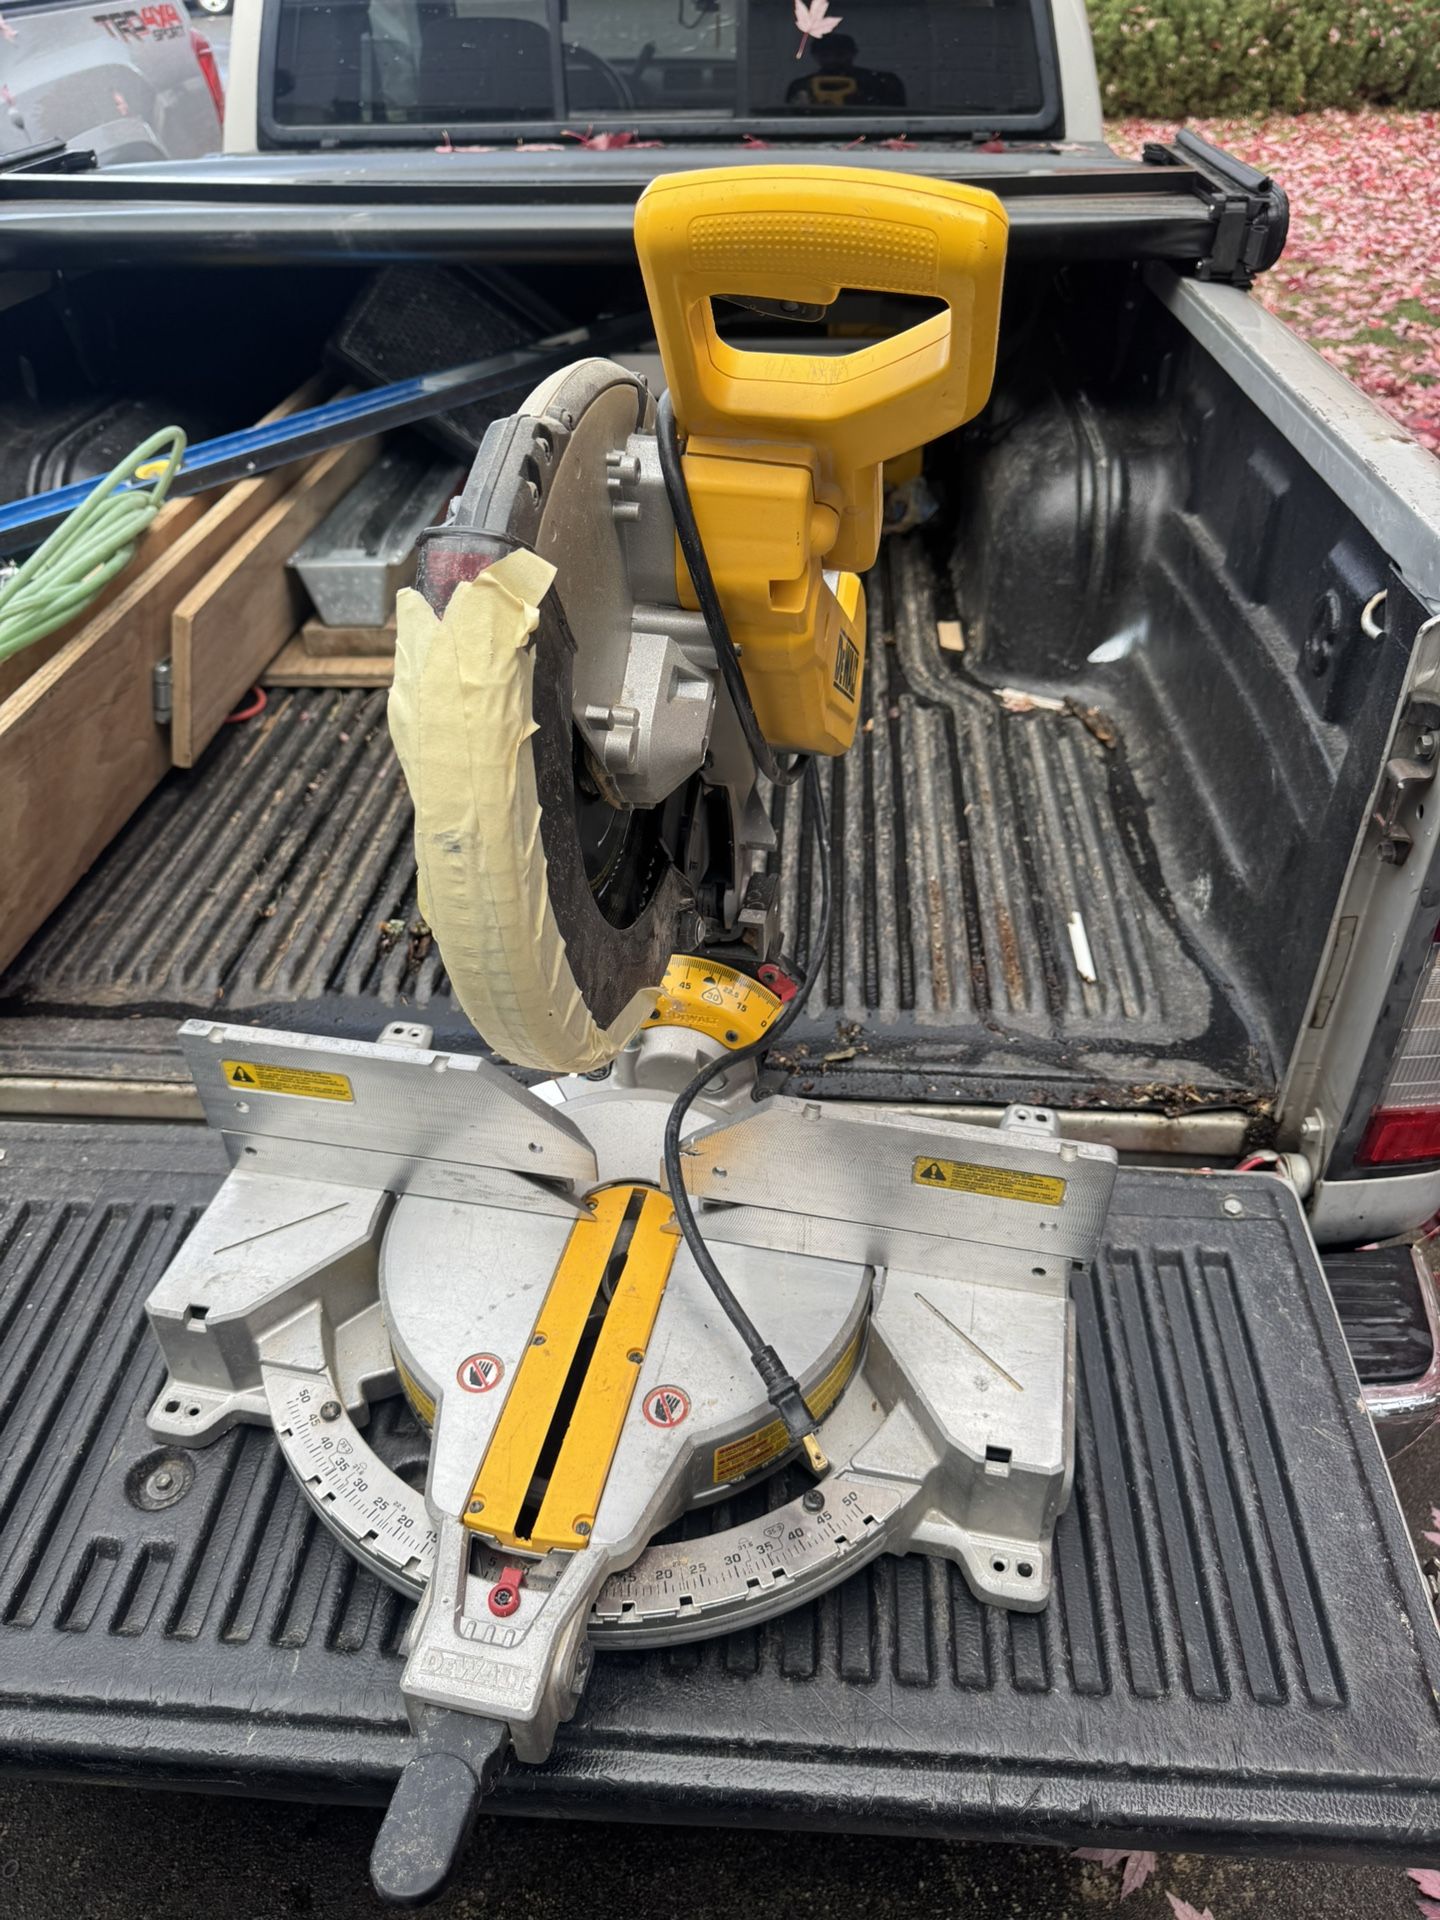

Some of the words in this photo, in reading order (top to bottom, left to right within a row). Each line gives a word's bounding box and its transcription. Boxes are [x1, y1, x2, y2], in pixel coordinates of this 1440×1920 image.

[679, 981, 691, 990] 45
[706, 992, 719, 1001] 30
[736, 1001, 748, 1012] 15
[760, 1020, 768, 1028] 0
[299, 1388, 311, 1404] 50
[308, 1413, 321, 1428] 45
[320, 1436, 334, 1450] 40
[335, 1457, 350, 1472] 35
[353, 1478, 369, 1493] 30
[373, 1497, 389, 1511] 25
[842, 1491, 858, 1507] 50
[398, 1514, 414, 1529] 20
[816, 1510, 832, 1525] 45
[426, 1530, 438, 1544] 15
[788, 1527, 804, 1541] 40
[756, 1541, 774, 1555] 35
[488, 1557, 496, 1567] 5
[724, 1553, 741, 1566] 30
[655, 1569, 673, 1580] 20
[689, 1563, 707, 1575] 25
